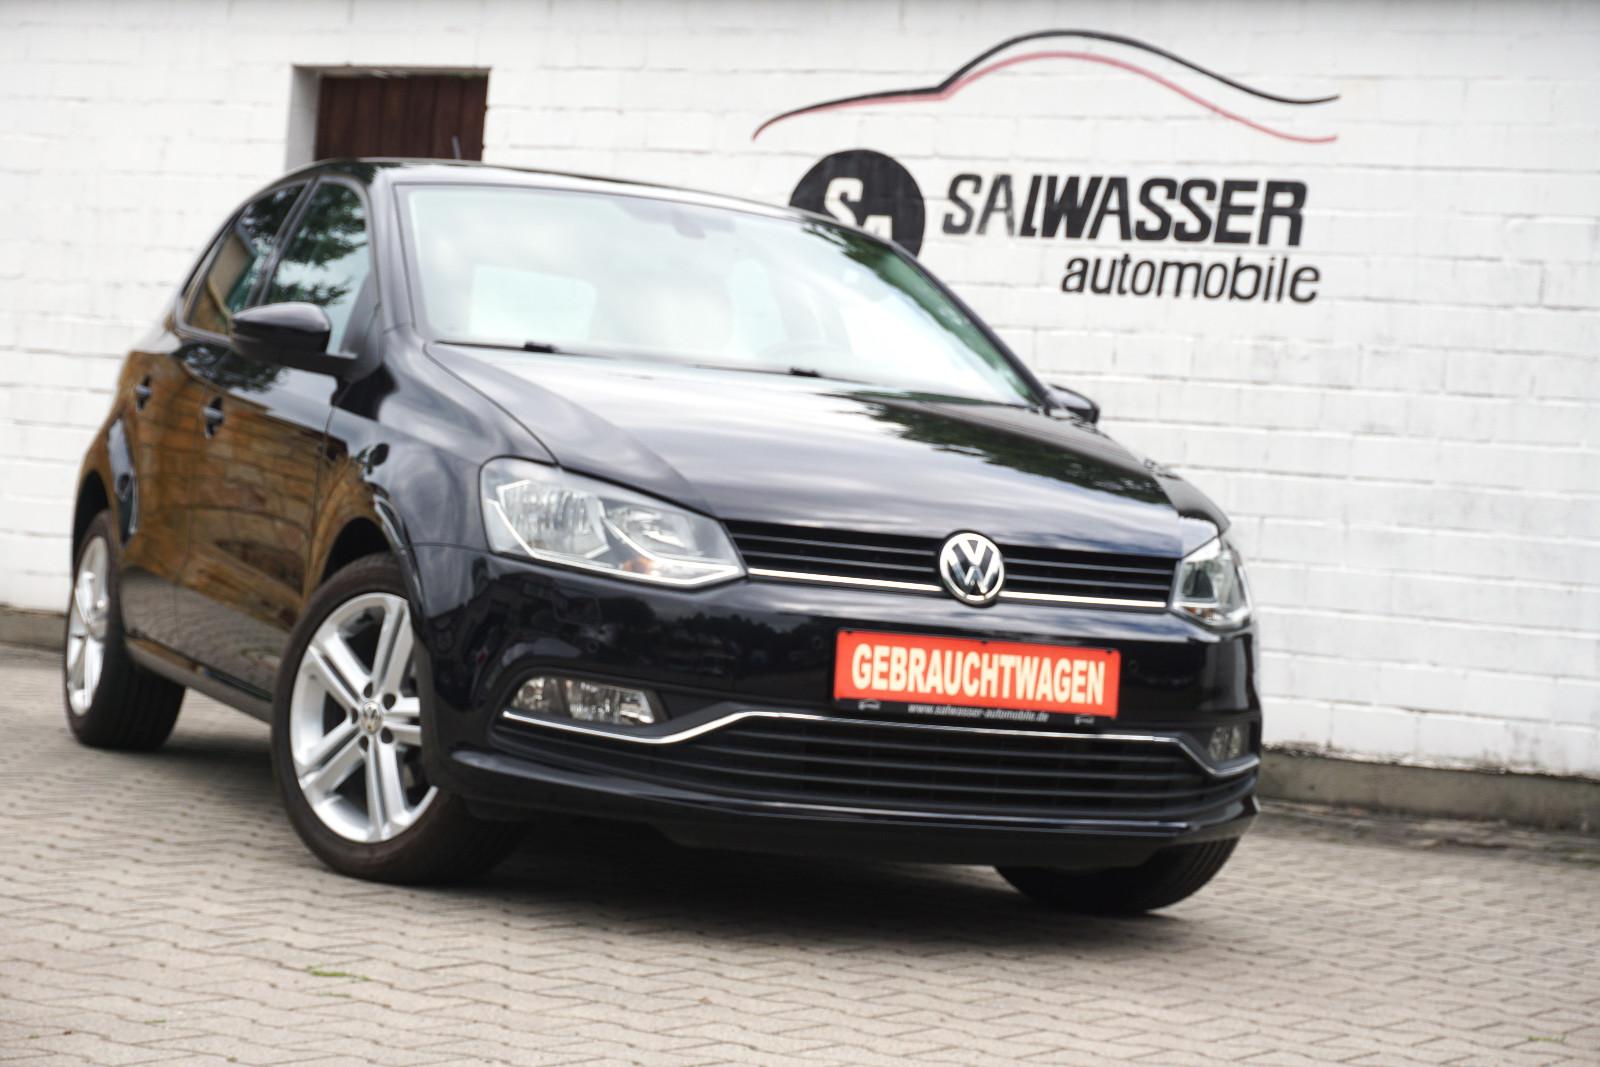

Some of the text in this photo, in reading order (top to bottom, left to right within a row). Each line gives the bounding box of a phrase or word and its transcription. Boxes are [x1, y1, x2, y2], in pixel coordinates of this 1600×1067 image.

[942, 173, 1306, 246] SALWASSER
[1062, 254, 1320, 304] automobile
[852, 643, 1106, 706] GEBRAUCHTWAGEN
